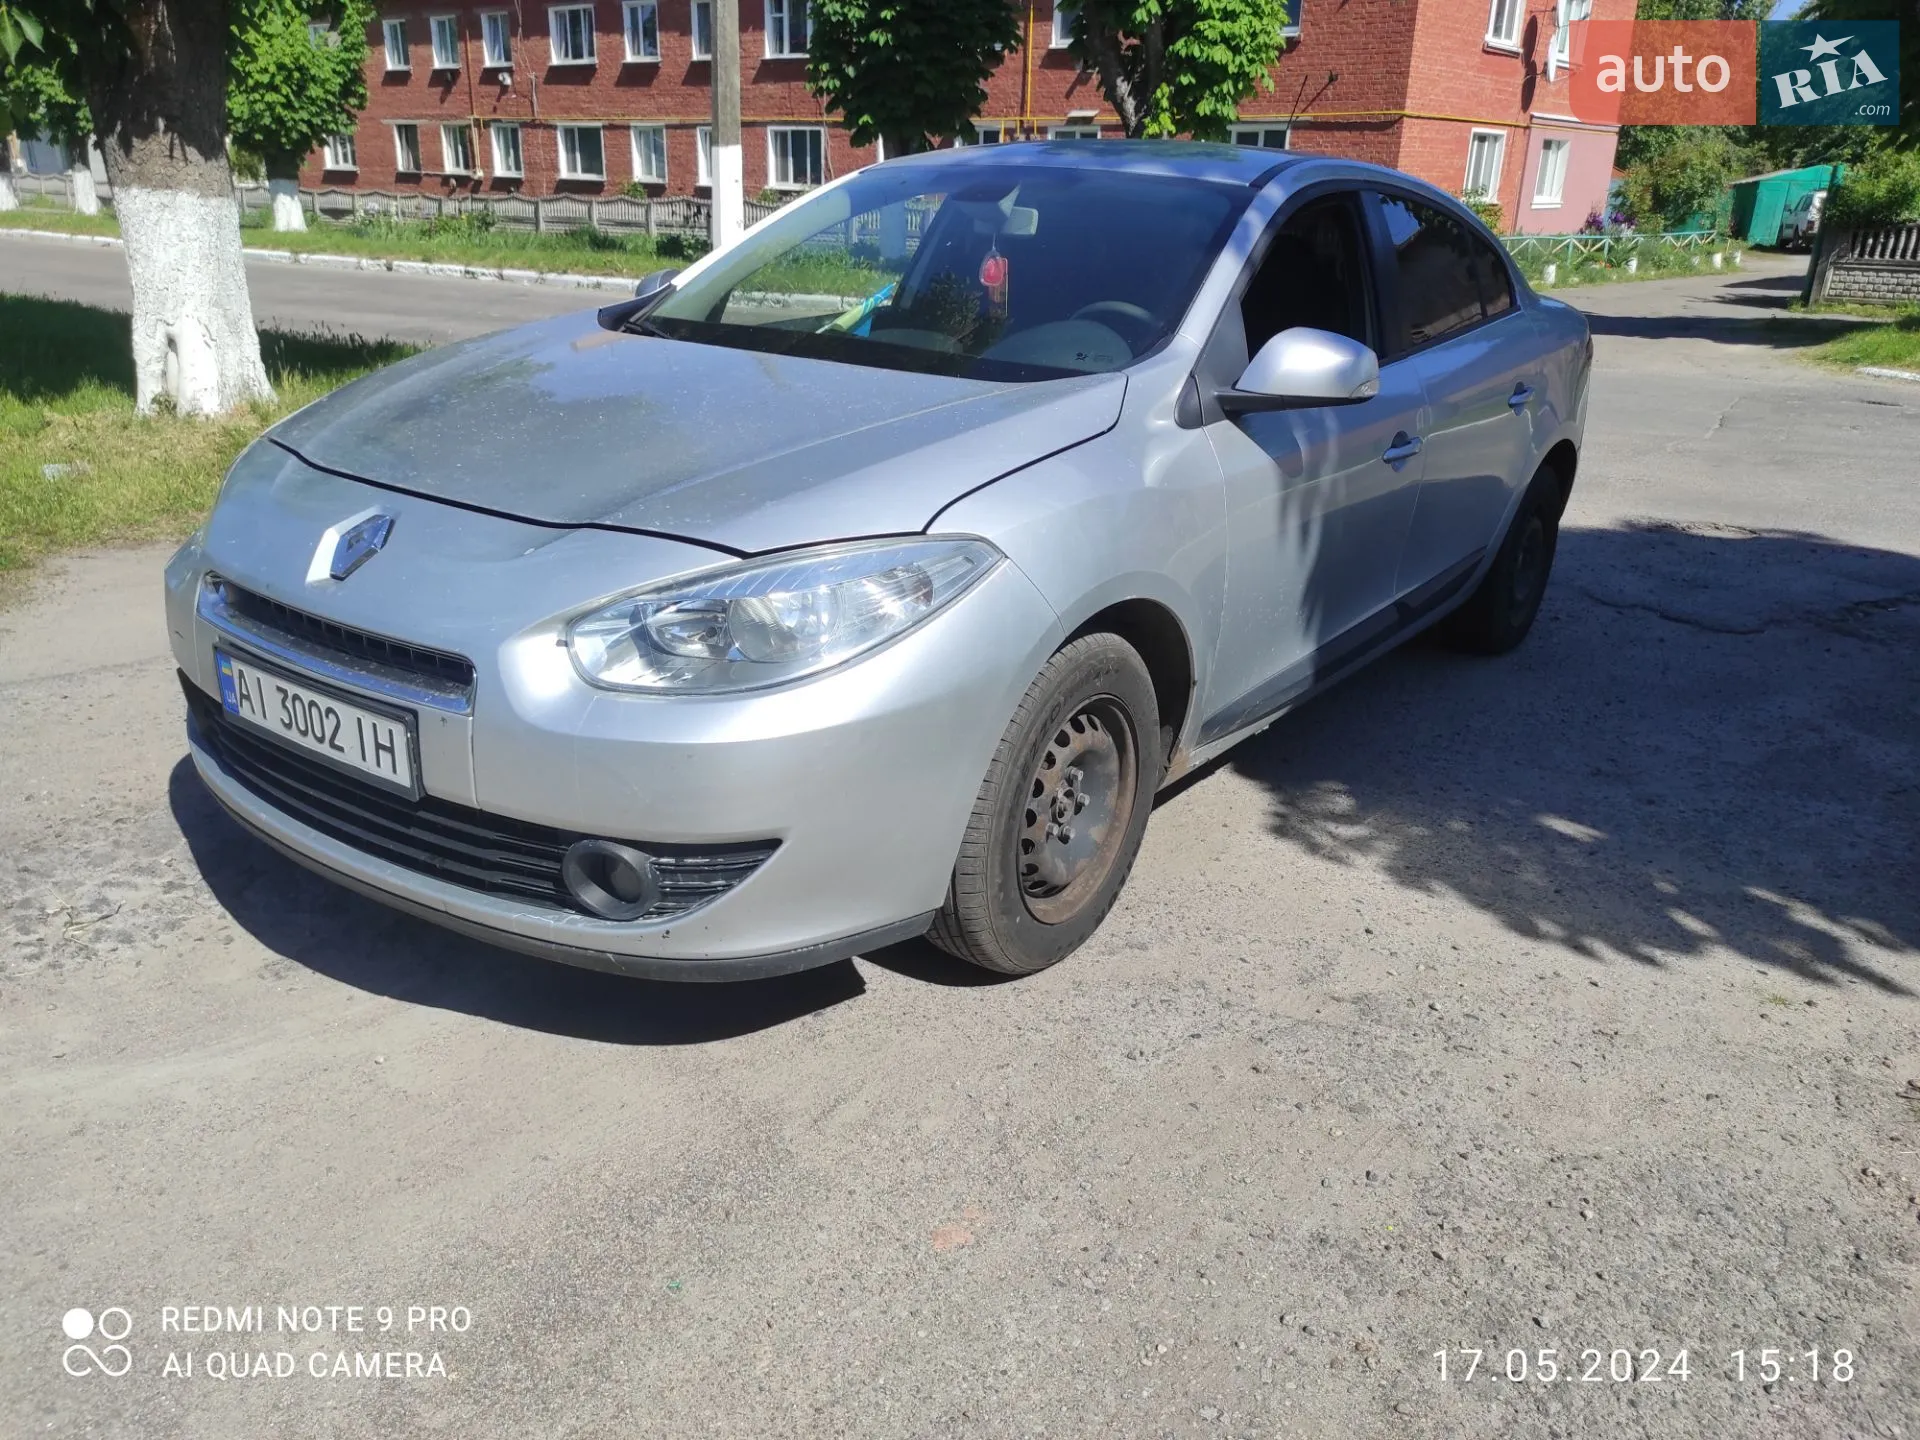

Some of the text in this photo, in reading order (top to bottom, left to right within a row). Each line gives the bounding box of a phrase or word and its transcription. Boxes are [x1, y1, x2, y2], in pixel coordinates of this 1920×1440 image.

[239, 668, 398, 775] AI 3002 IH
